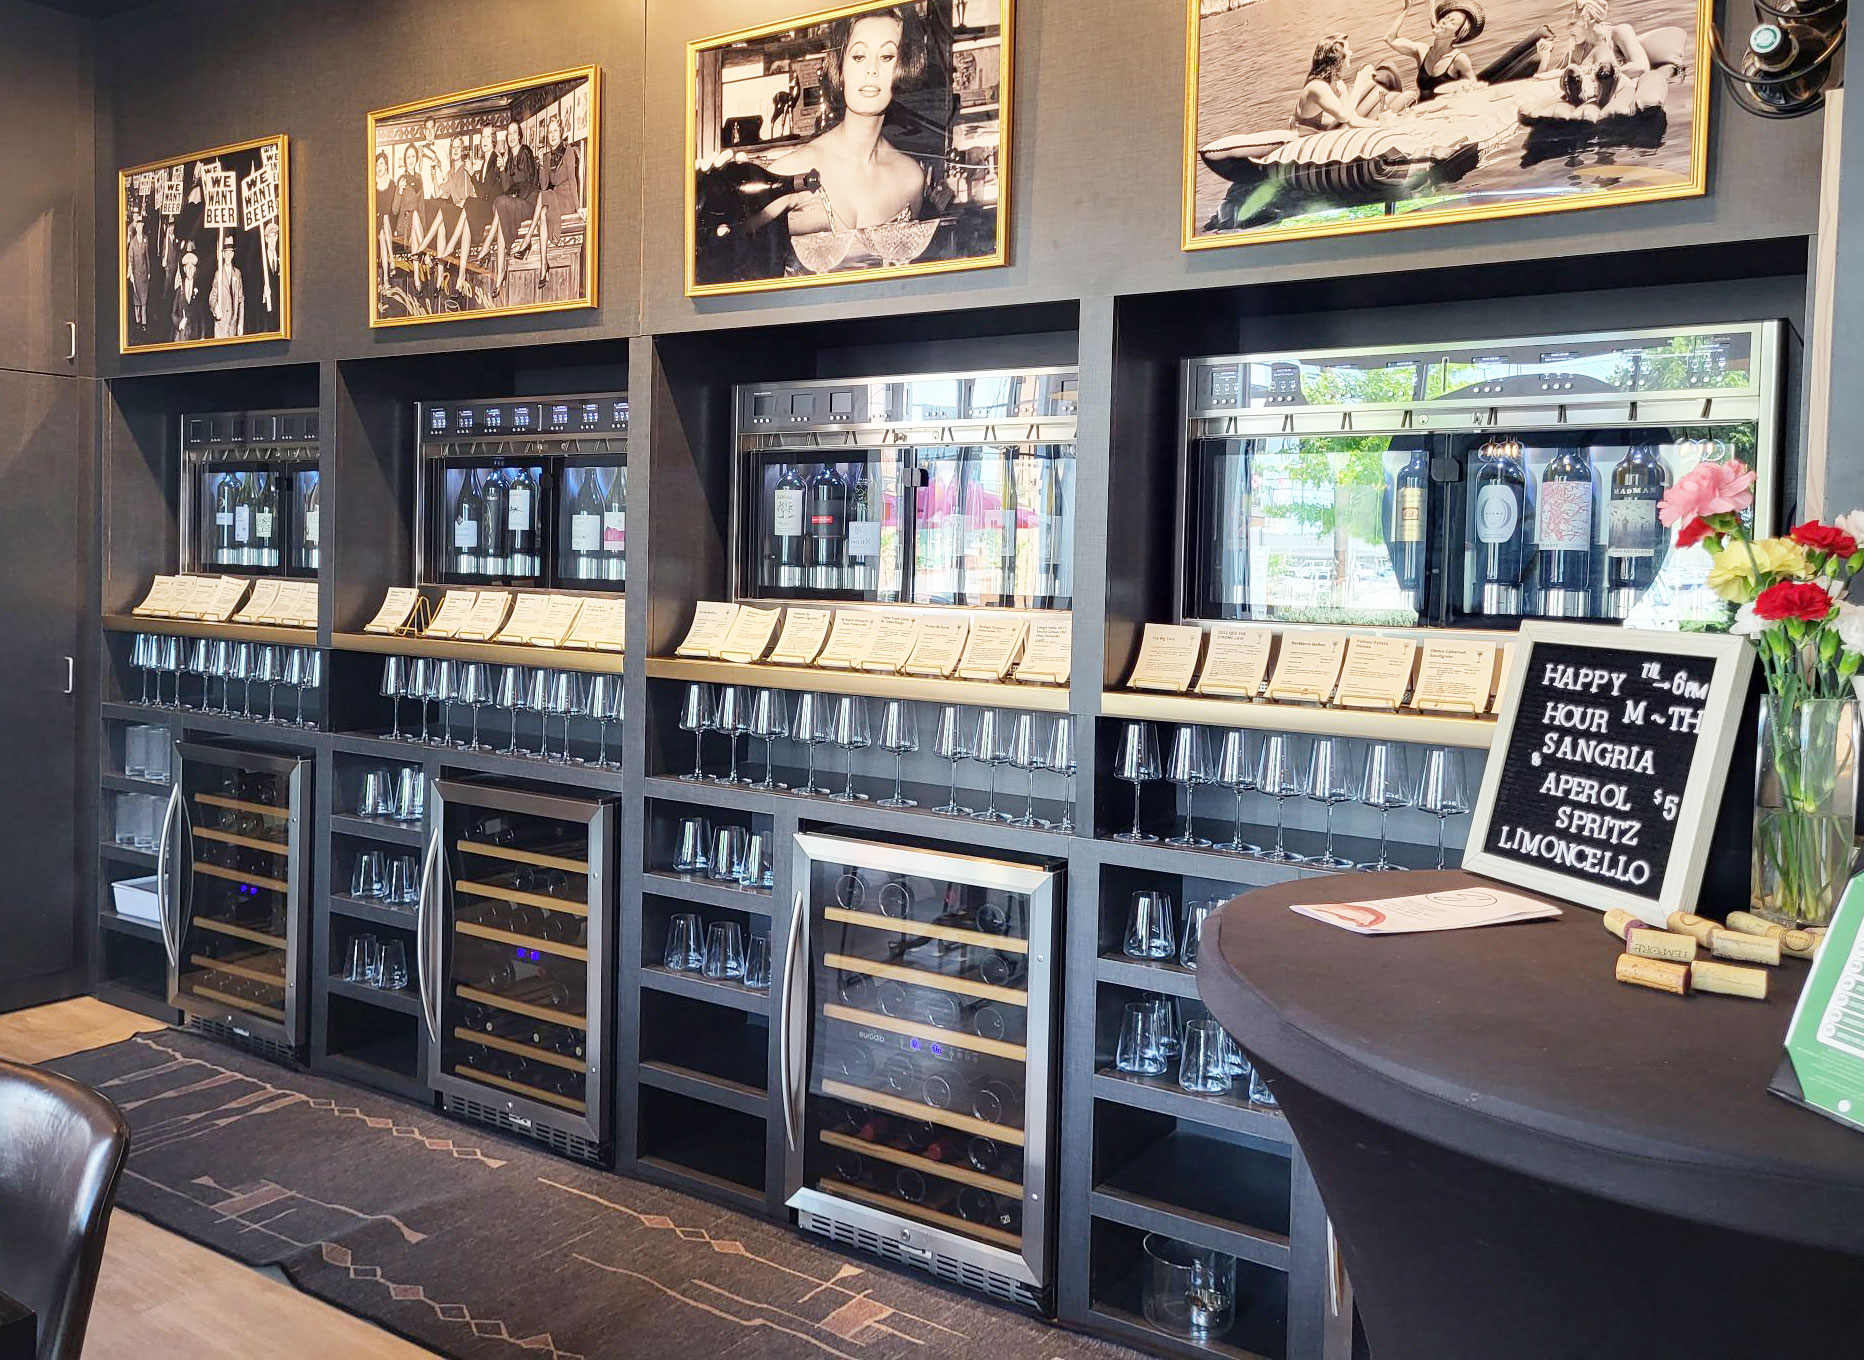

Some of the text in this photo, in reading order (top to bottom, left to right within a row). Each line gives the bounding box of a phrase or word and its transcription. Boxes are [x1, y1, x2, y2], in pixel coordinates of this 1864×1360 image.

[168, 183, 180, 191] WE
[211, 176, 231, 188] WE
[246, 171, 268, 192] WE
[163, 203, 180, 212] BEER
[165, 193, 181, 203] WANT
[208, 190, 234, 206] WANT
[245, 182, 272, 209] WANT
[207, 207, 235, 224] BEER
[246, 199, 275, 226] BEER
[1542, 663, 1627, 696] HAPPY
[1542, 701, 1609, 734] HOUR
[1542, 733, 1656, 775] SANGRIA
[1539, 771, 1632, 812] APEROL
[1555, 807, 1642, 846] SPRITZ
[1498, 826, 1651, 885] LIMONCELLO
